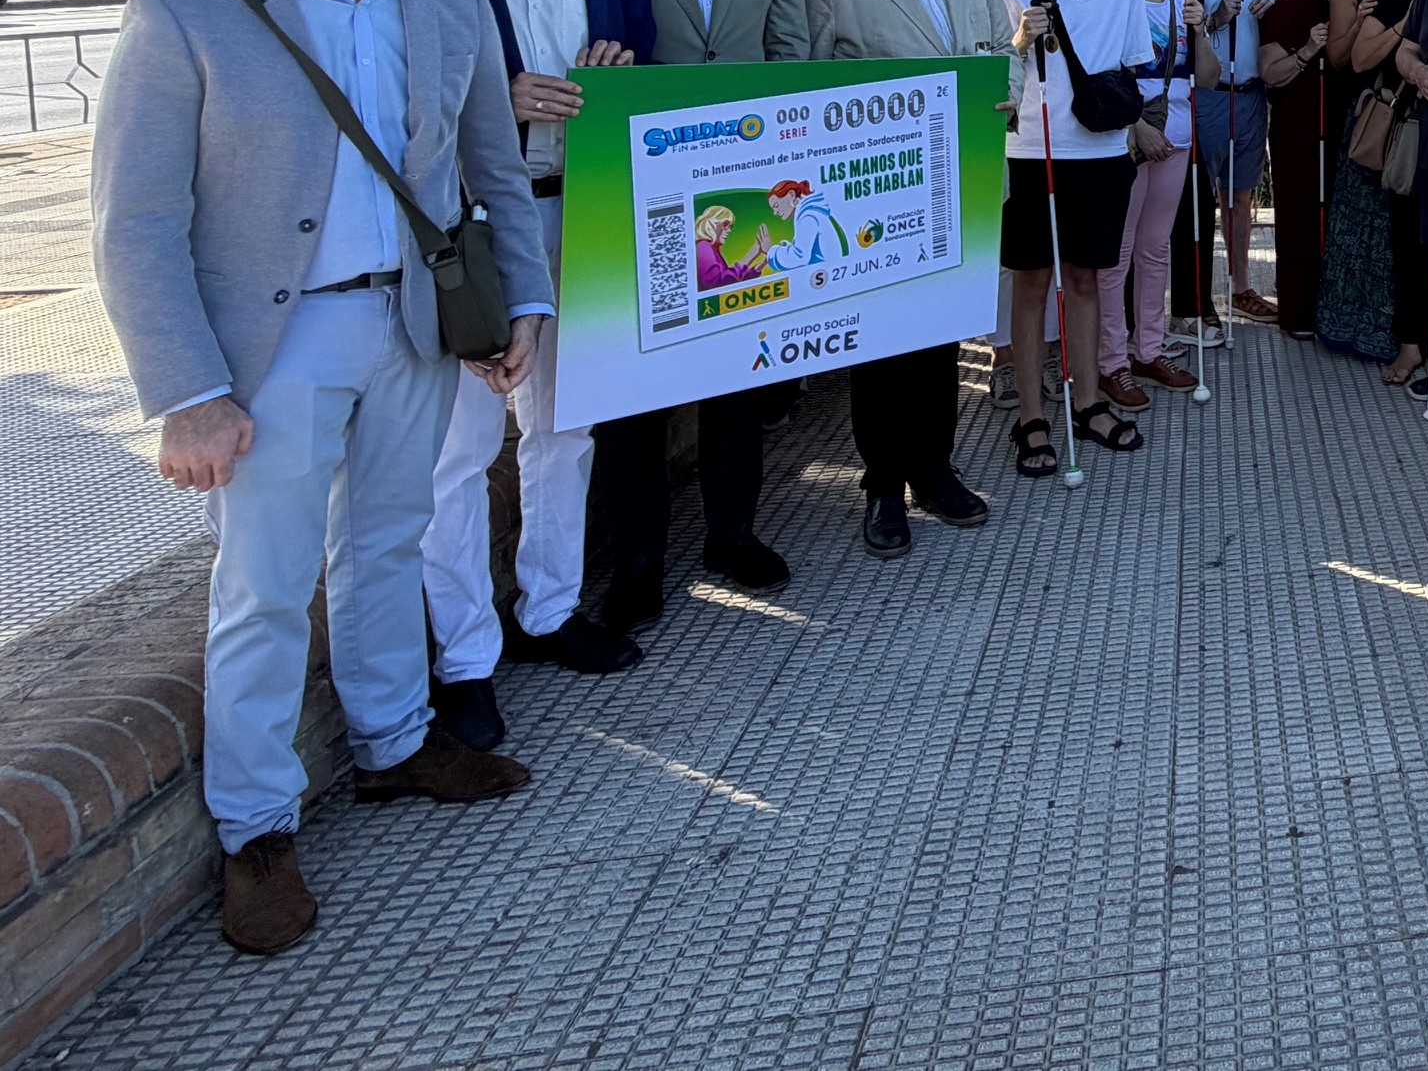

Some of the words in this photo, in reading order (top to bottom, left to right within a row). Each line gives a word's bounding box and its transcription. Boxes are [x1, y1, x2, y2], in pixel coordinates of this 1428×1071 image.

[937, 85, 950, 98] 2€
[776, 105, 810, 125] 000
[824, 89, 926, 132] 00000
[700, 137, 739, 150] SEMANA
[779, 126, 808, 140] SERIE
[692, 167, 709, 179] Día
[712, 155, 775, 176] Internacional
[777, 152, 789, 164] de
[791, 149, 805, 161] las
[807, 143, 848, 159] Personas
[850, 139, 866, 151] con
[867, 131, 923, 148] Sordoceguera
[820, 162, 847, 185] LAS
[849, 152, 896, 179] MANOS
[898, 147, 924, 170] QUE
[844, 178, 871, 202] NOS
[874, 167, 924, 195] HABLAN
[886, 216, 926, 234] ONCE
[887, 208, 925, 223] Fundación
[884, 228, 926, 243] Sordoceguera
[815, 272, 825, 286] S
[831, 266, 848, 282] 27
[851, 258, 883, 277] JUN.
[885, 254, 901, 268] 26
[725, 281, 785, 309] ONCE
[781, 323, 821, 342] grupo
[824, 312, 860, 331] social
[780, 329, 859, 364] ONCE
